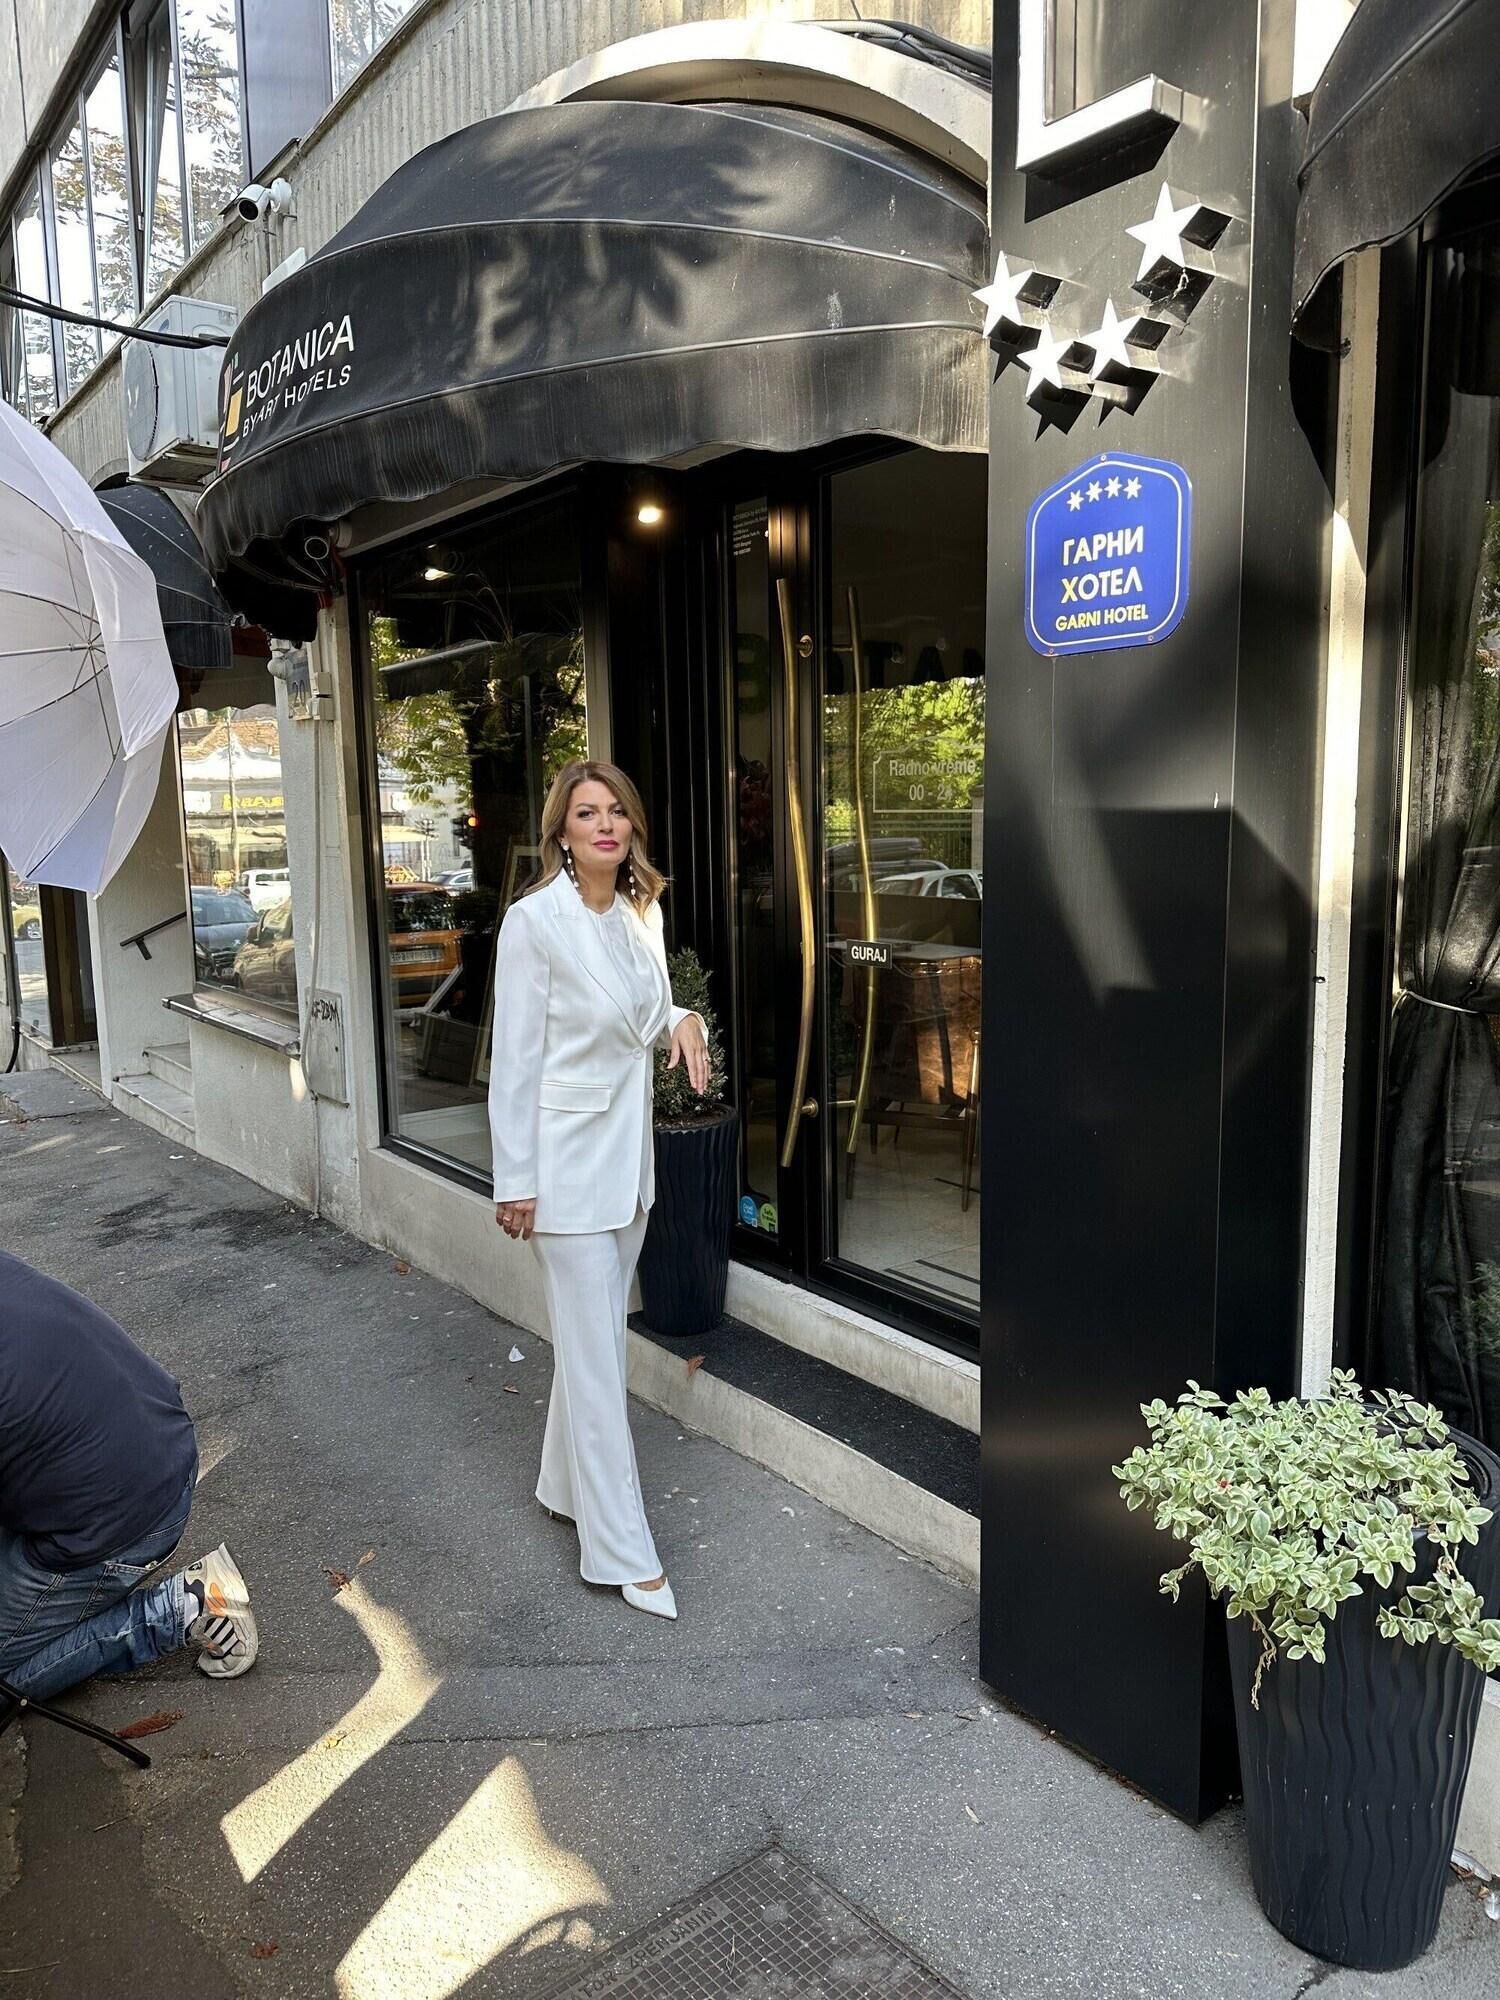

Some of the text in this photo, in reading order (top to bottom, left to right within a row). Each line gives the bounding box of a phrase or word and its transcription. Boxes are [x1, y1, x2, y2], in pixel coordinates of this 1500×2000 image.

[246, 315, 355, 408] BOTANICA
[284, 365, 351, 408] HOTELS
[1063, 526, 1144, 566] ГАРНИ
[1061, 566, 1143, 604] ХОТЕЛ
[1055, 604, 1149, 631] GARNI HOTEL
[890, 759, 929, 777] Radno
[851, 945, 887, 962] GURAJ
